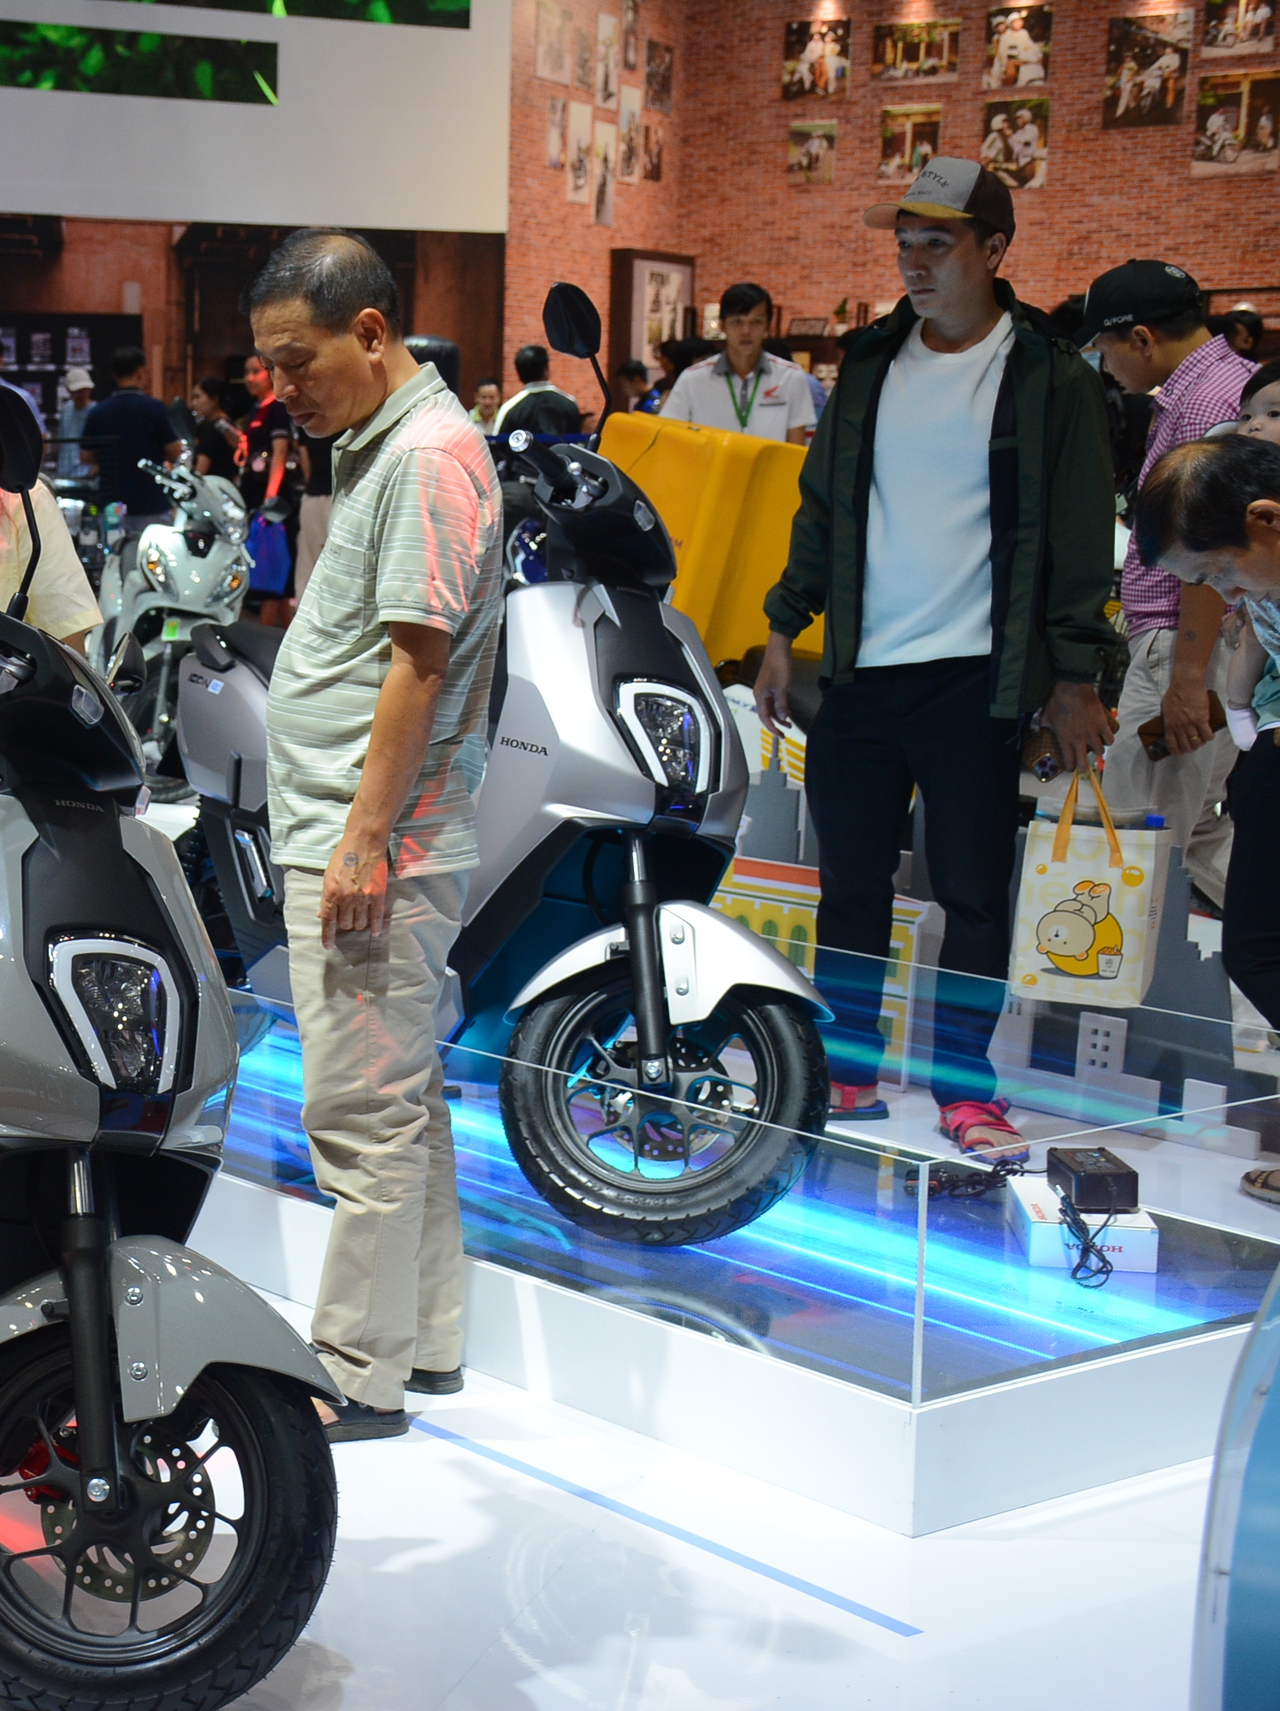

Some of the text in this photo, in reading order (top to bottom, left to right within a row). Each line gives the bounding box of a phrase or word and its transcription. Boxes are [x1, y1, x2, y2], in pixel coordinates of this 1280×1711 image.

[499, 736, 548, 756] HONDA
[54, 799, 105, 813] HONDA
[1064, 1242, 1124, 1254] HODA
